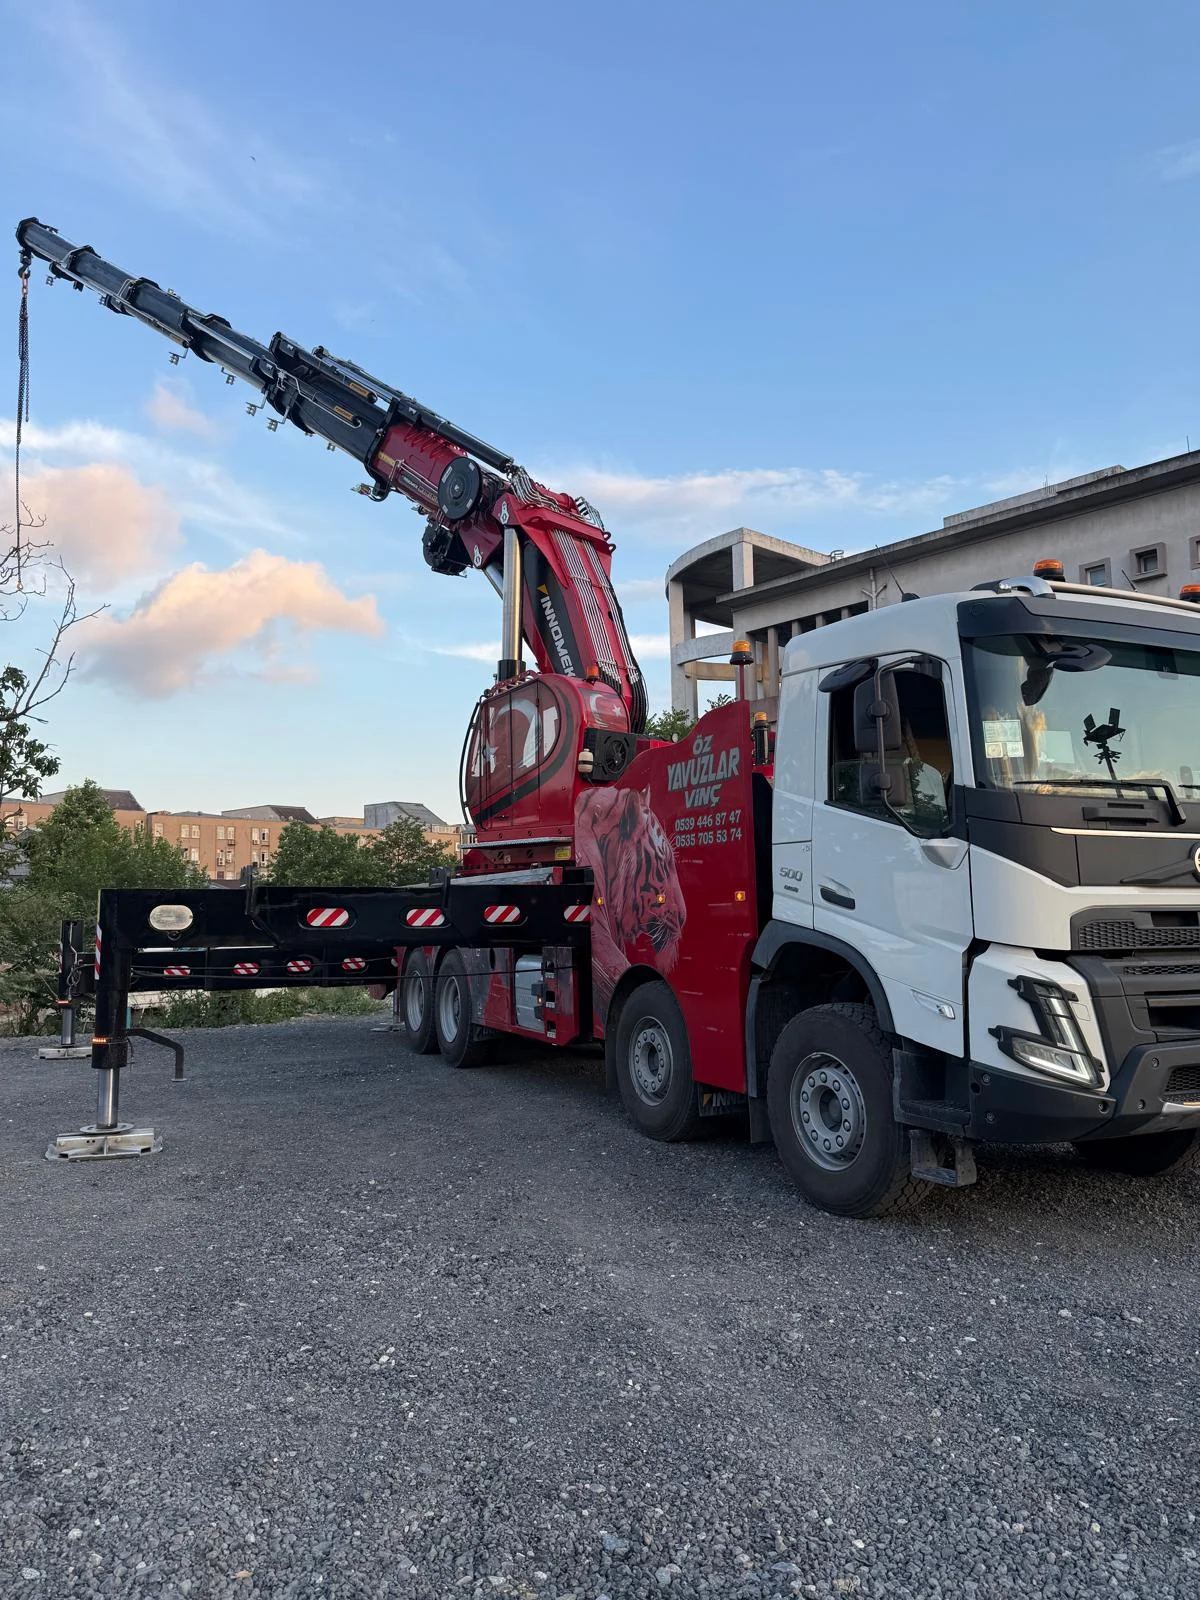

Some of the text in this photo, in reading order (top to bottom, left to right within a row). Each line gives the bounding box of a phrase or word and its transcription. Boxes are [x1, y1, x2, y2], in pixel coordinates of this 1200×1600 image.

[692, 735, 713, 755] ÖZ
[667, 747, 740, 791] YAVUZLAR
[675, 809, 742, 832] 0539 446 87 47
[675, 833, 696, 848] 0535
[698, 831, 714, 846] 705
[730, 827, 743, 841] 74
[779, 866, 803, 882] 500
